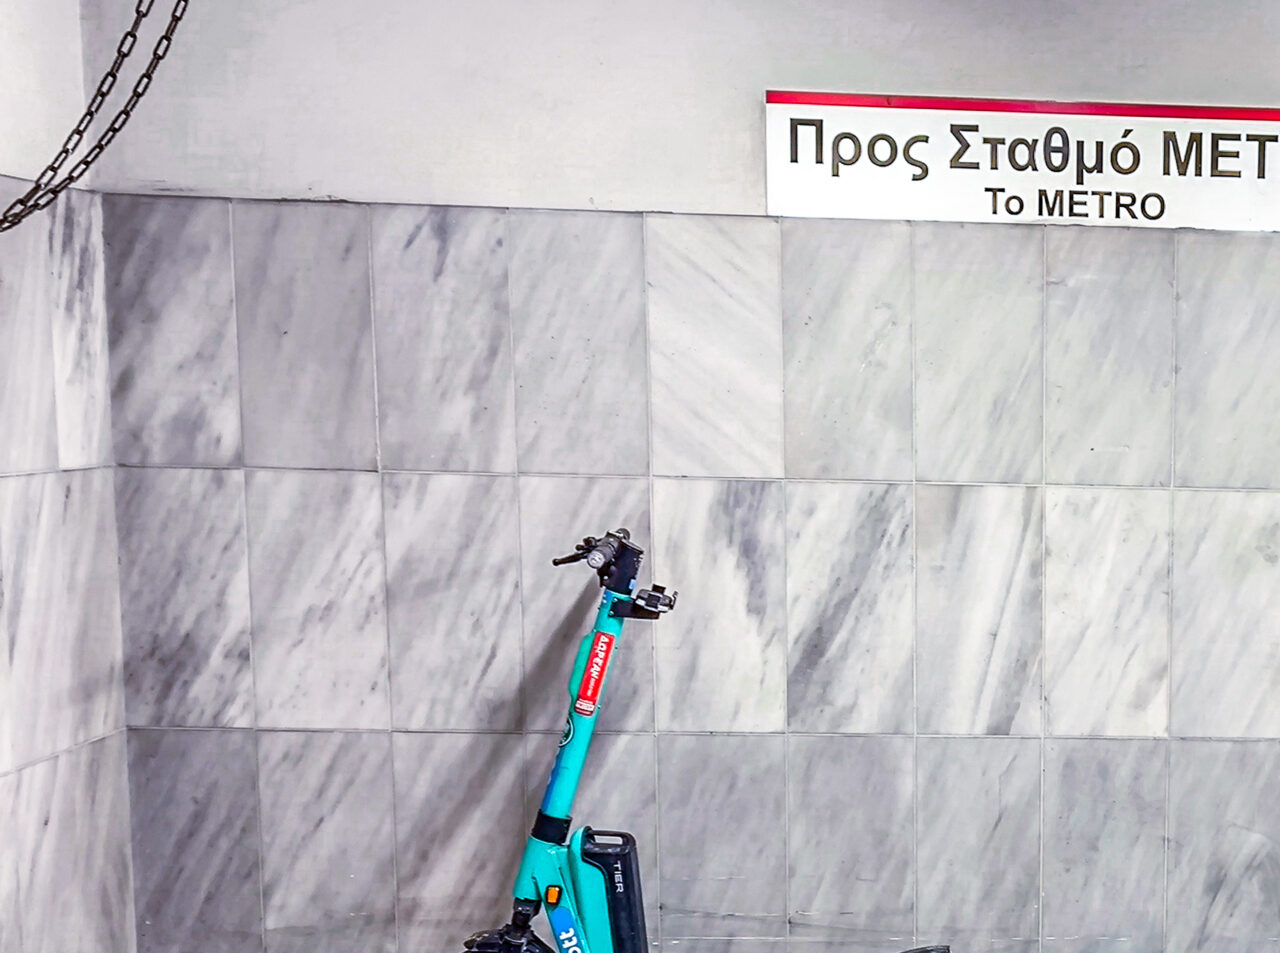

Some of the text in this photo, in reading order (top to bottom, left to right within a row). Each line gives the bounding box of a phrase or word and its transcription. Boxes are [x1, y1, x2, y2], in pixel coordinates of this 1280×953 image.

[789, 117, 930, 182] Προς
[949, 123, 1141, 186] Σταθμό
[984, 187, 1167, 221] To METRO
[613, 860, 624, 893] TIER
